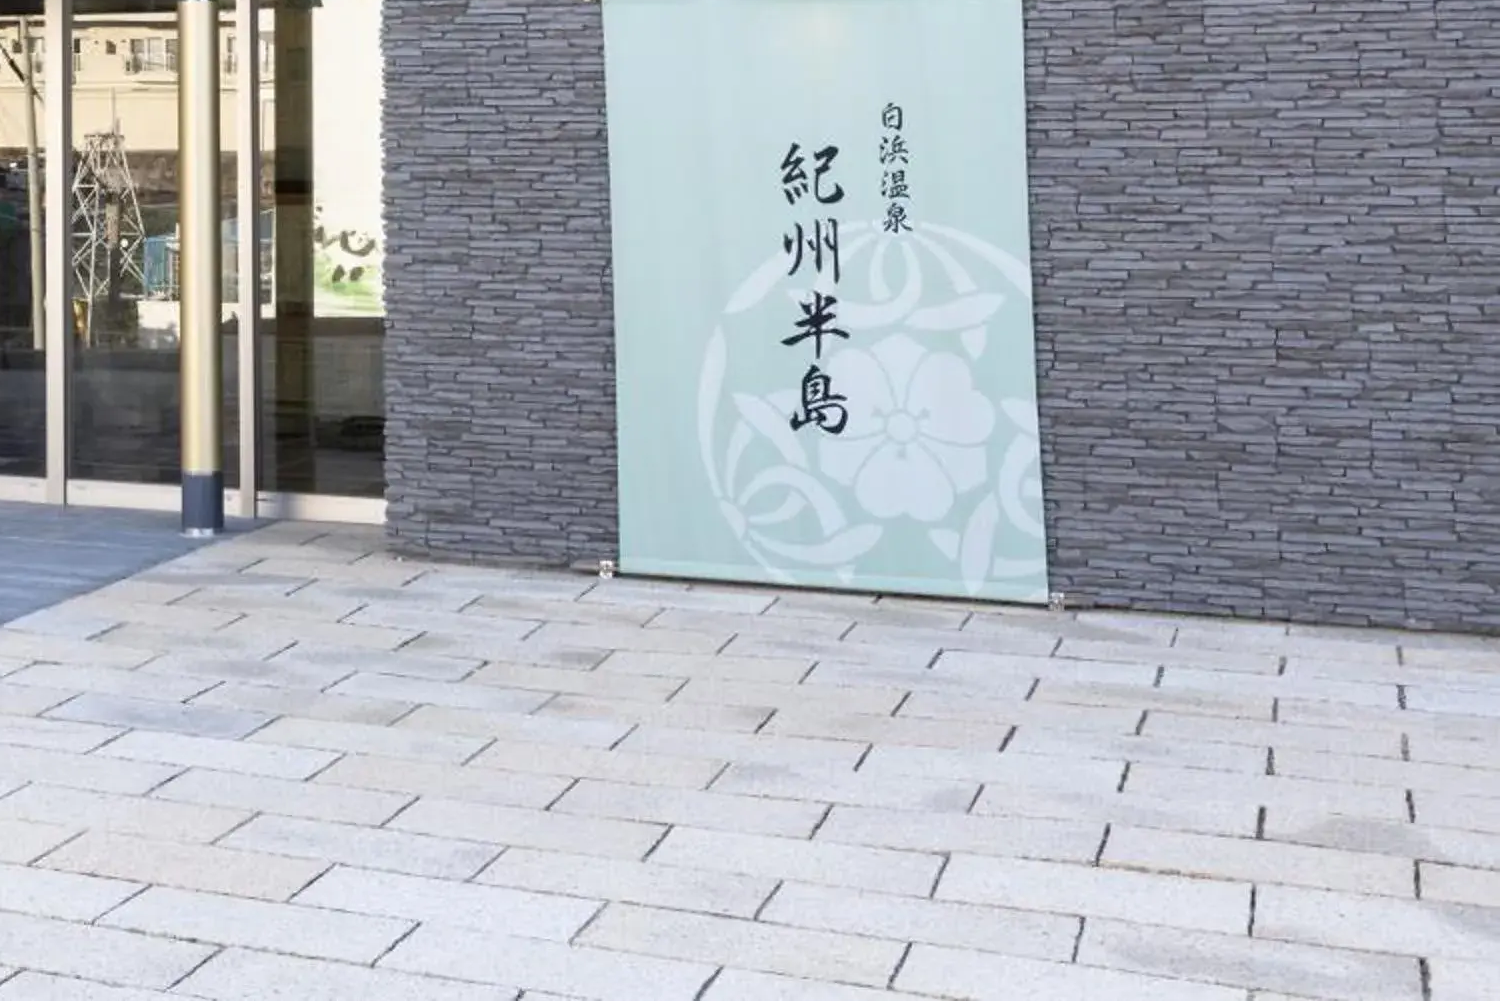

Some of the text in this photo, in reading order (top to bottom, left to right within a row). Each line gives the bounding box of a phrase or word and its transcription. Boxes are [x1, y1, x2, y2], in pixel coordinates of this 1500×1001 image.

[879, 102, 913, 235] 白浜温泉
[780, 142, 850, 435] 紀州半島
